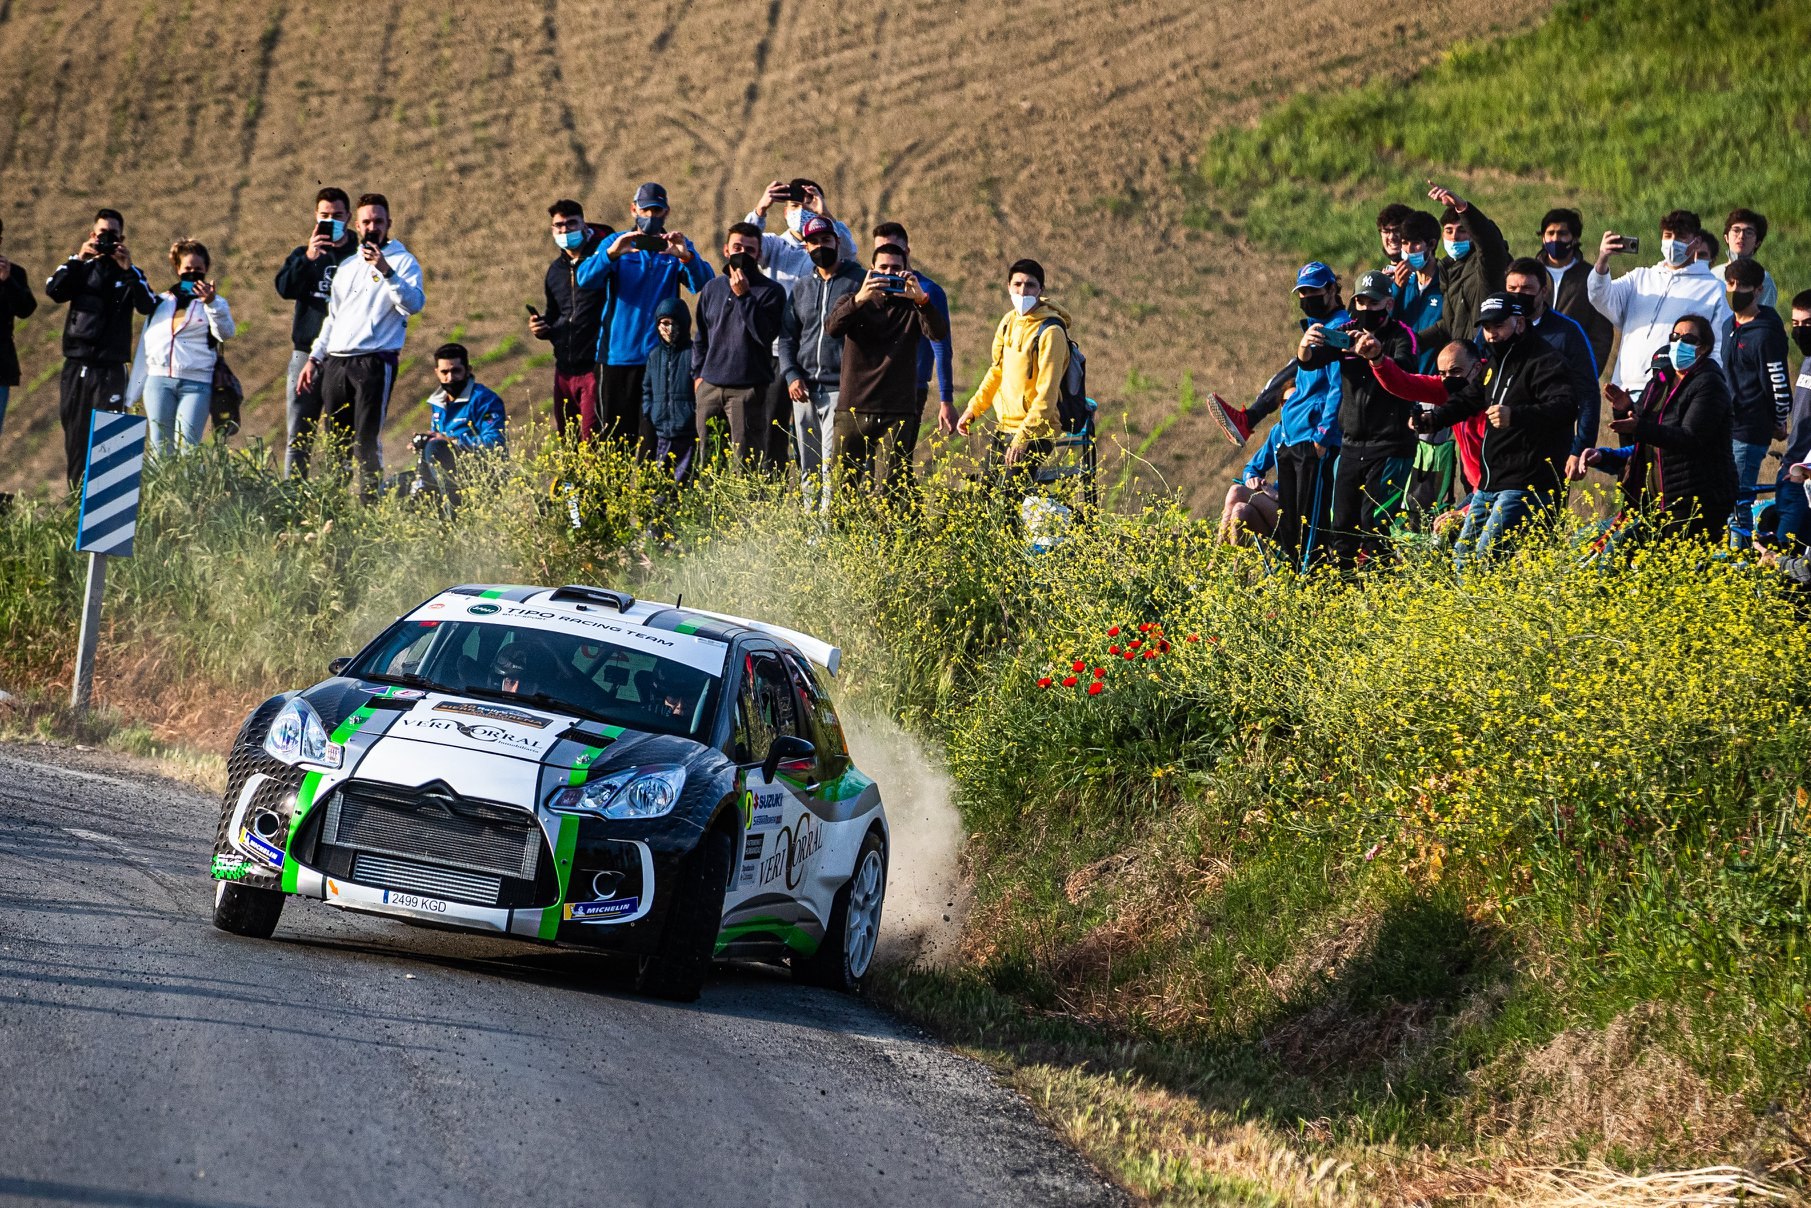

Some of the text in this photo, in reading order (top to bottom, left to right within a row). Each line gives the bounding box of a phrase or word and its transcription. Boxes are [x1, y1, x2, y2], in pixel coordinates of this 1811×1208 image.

[508, 607, 675, 647] TIPO RACING TEAM
[759, 793, 783, 809] SUZUKI
[249, 839, 279, 860] MICHELIN
[392, 893, 447, 913] 2499 KGD
[586, 903, 630, 915] MICHELIN
